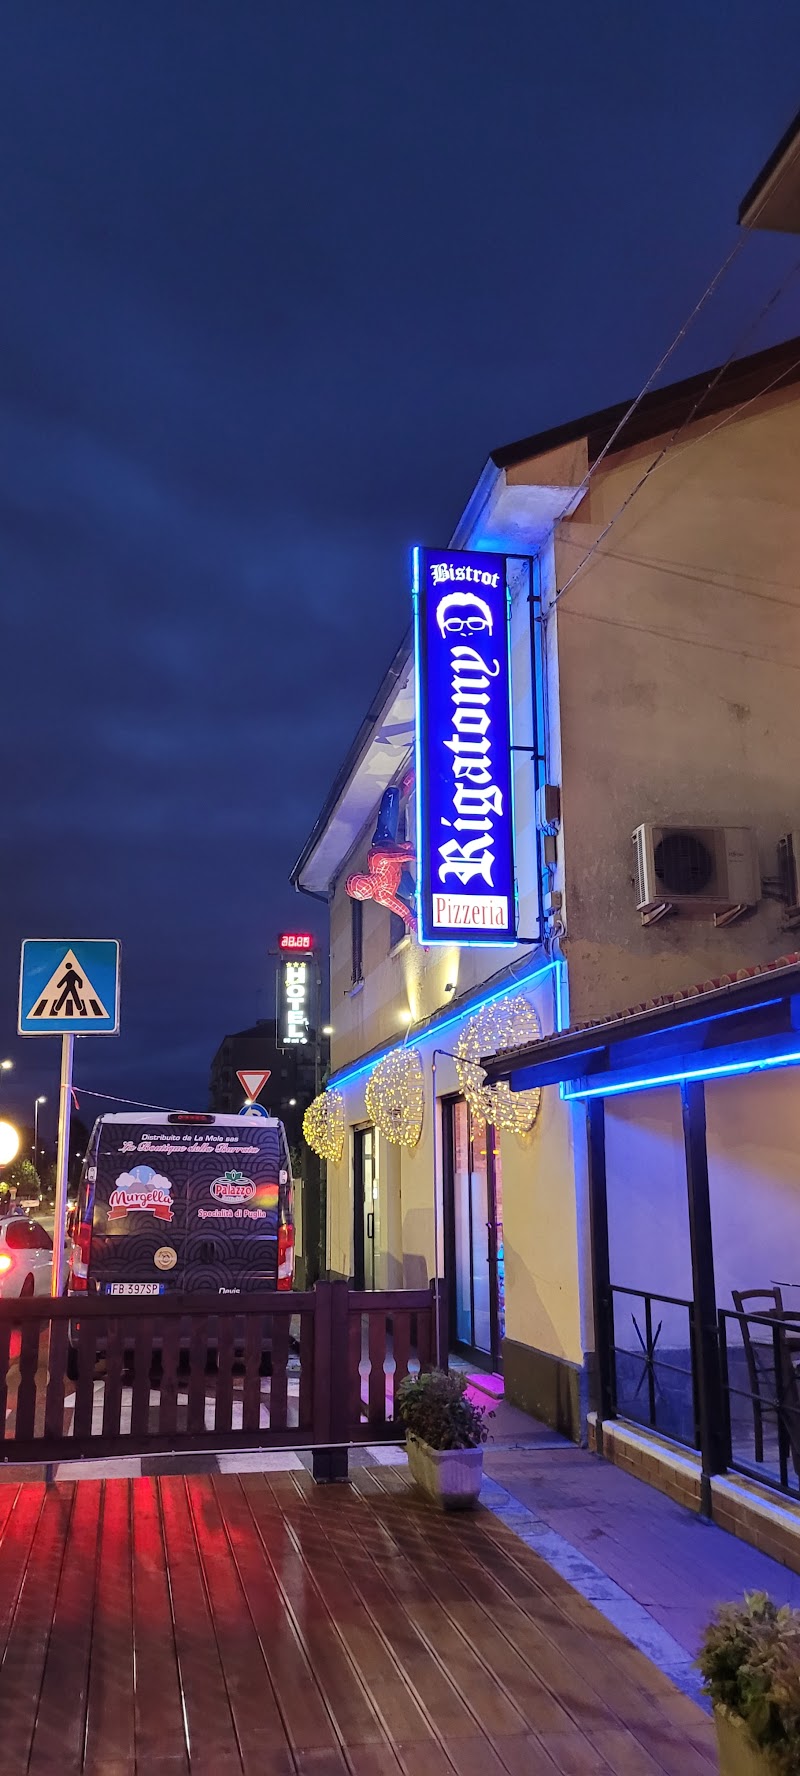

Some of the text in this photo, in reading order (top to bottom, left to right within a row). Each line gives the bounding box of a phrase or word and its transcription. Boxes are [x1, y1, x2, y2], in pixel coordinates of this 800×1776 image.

[430, 563, 500, 588] Bistrot
[438, 646, 503, 887] Rigatony
[436, 897, 505, 926] Pizzeria
[286, 966, 306, 1038] HOTEL
[141, 1133, 180, 1141] Distribuito
[137, 1141, 187, 1155] Boutique
[215, 1184, 252, 1195] Palazzo
[110, 1190, 172, 1207] Murgella
[198, 1209, 267, 1219] Specialità di Puglia
[112, 1284, 125, 1294] FB
[128, 1284, 158, 1294] 397SP
